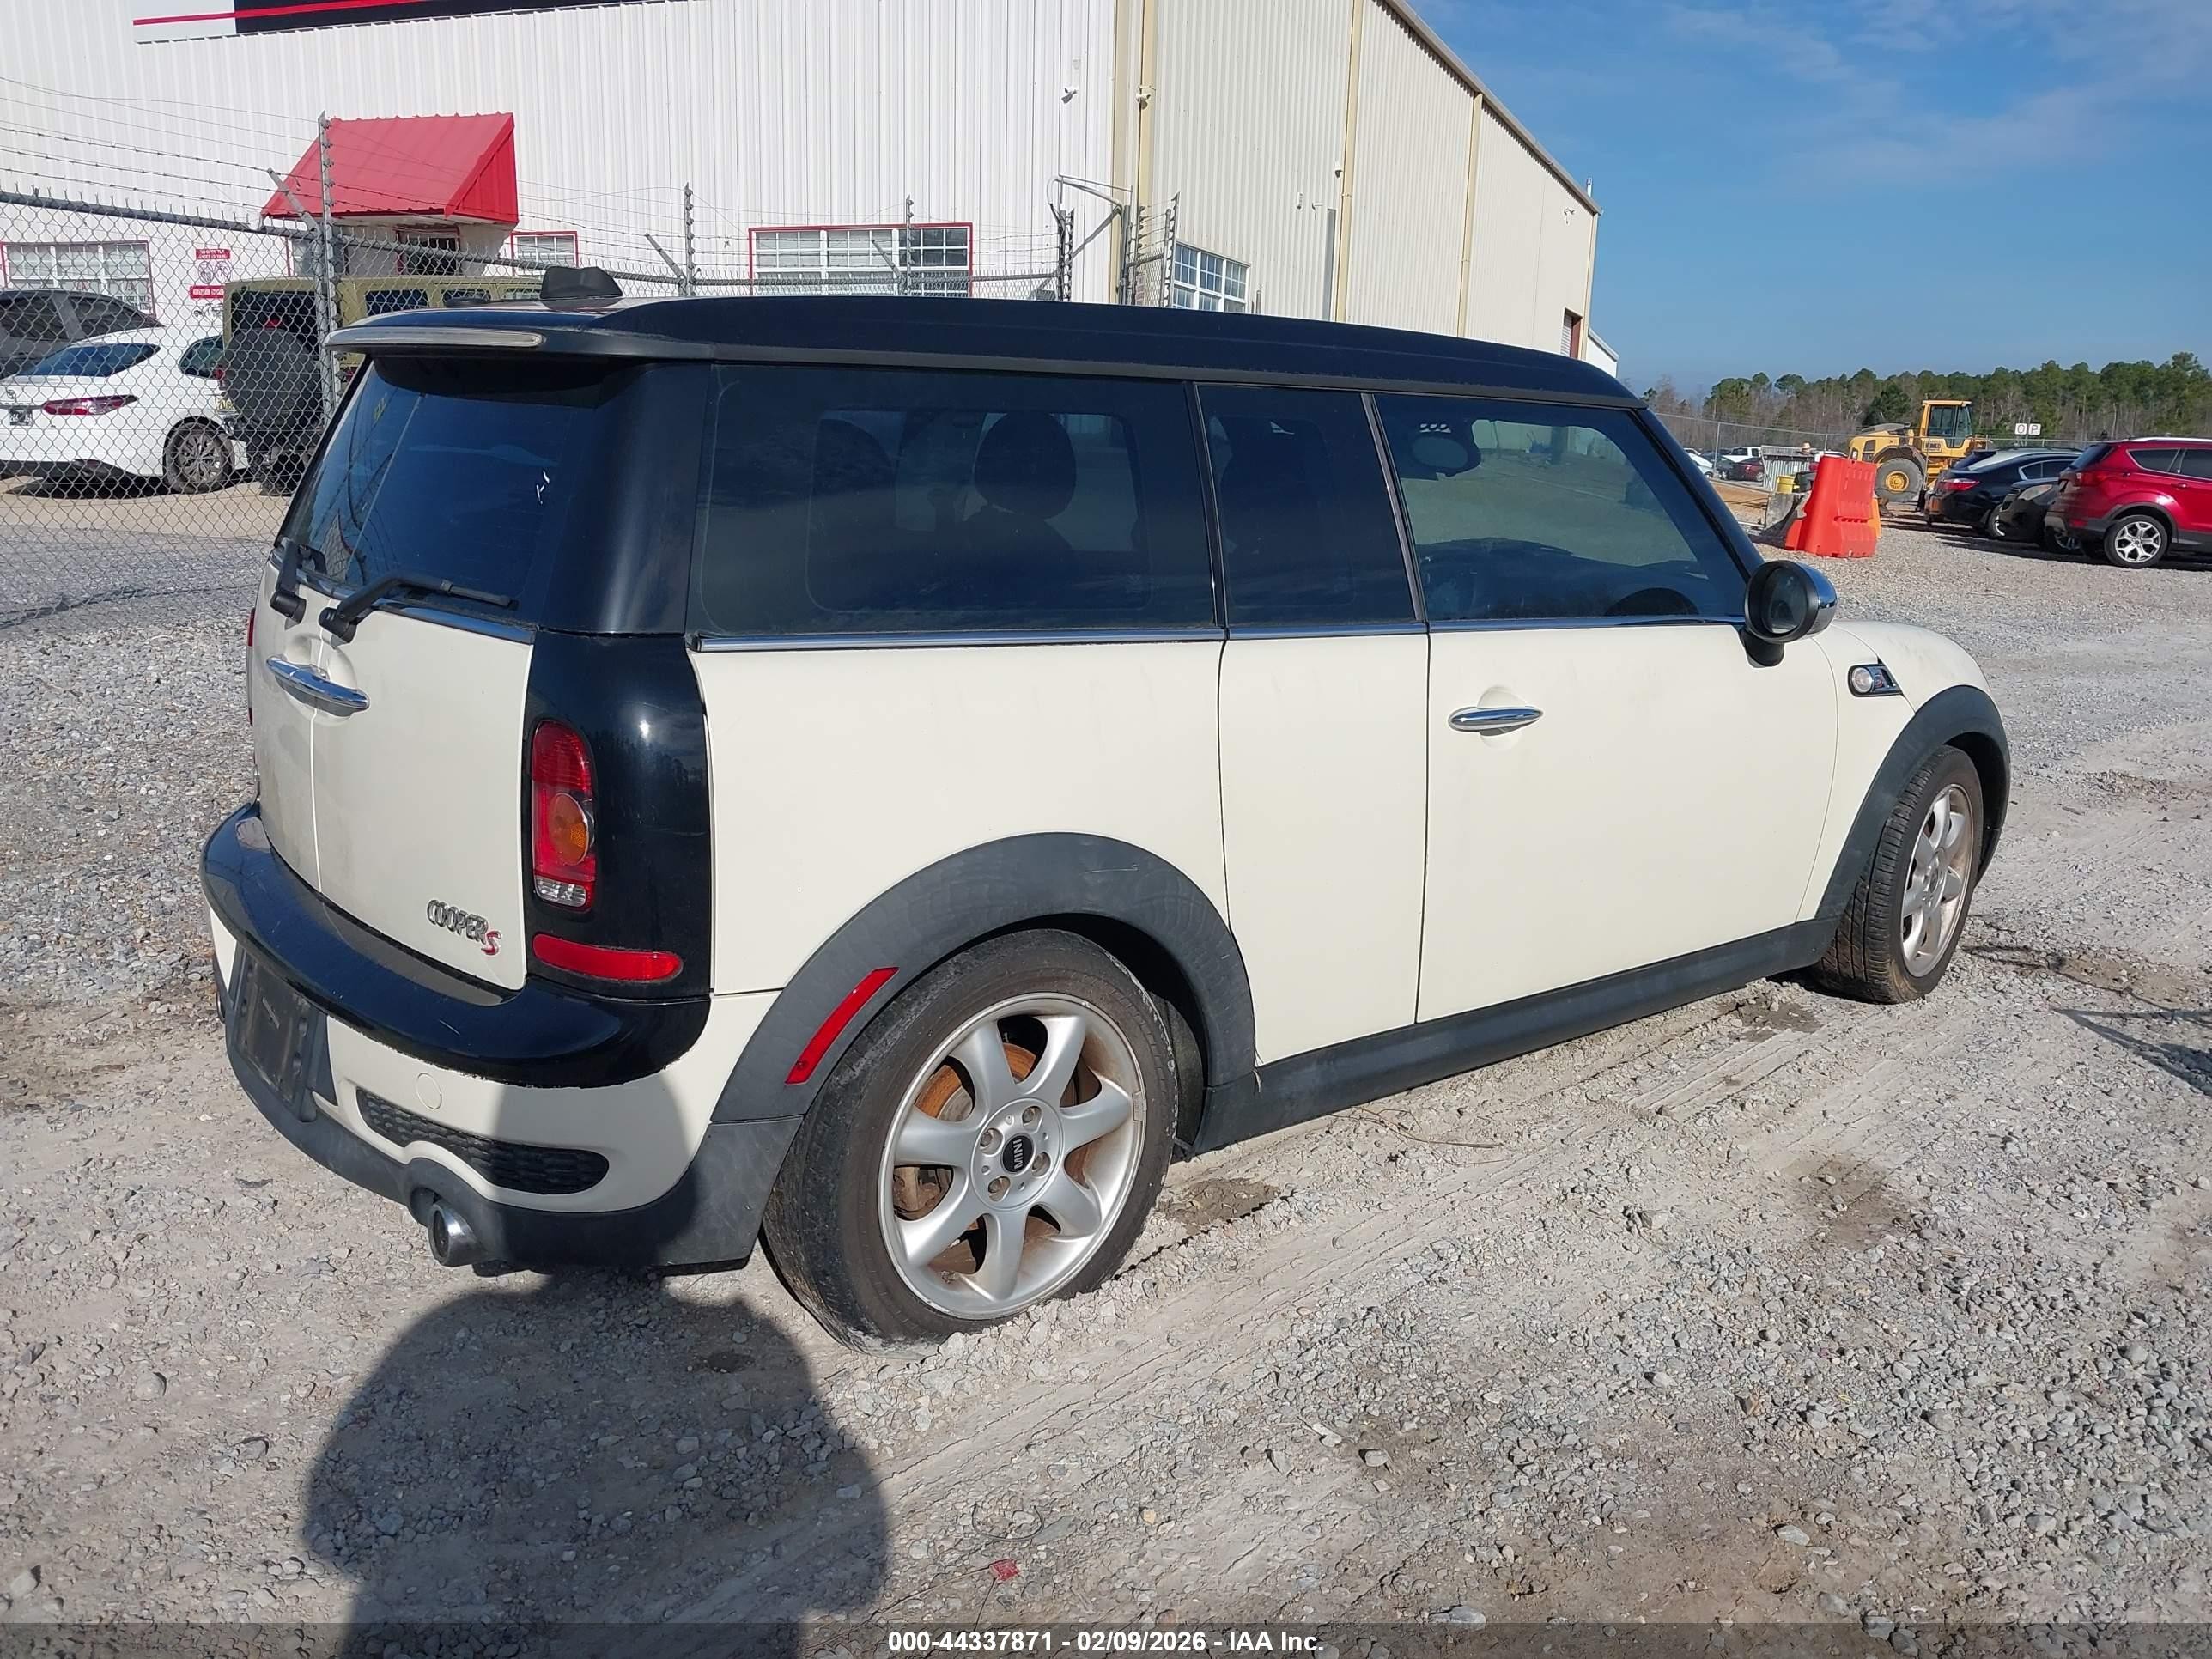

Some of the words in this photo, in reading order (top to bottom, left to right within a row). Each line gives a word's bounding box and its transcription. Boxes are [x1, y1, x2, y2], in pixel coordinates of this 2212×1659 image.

[2030, 424, 2039, 434] P
[427, 899, 489, 945] COOPER
[480, 930, 502, 956] S
[1012, 1139, 1024, 1170] MINI
